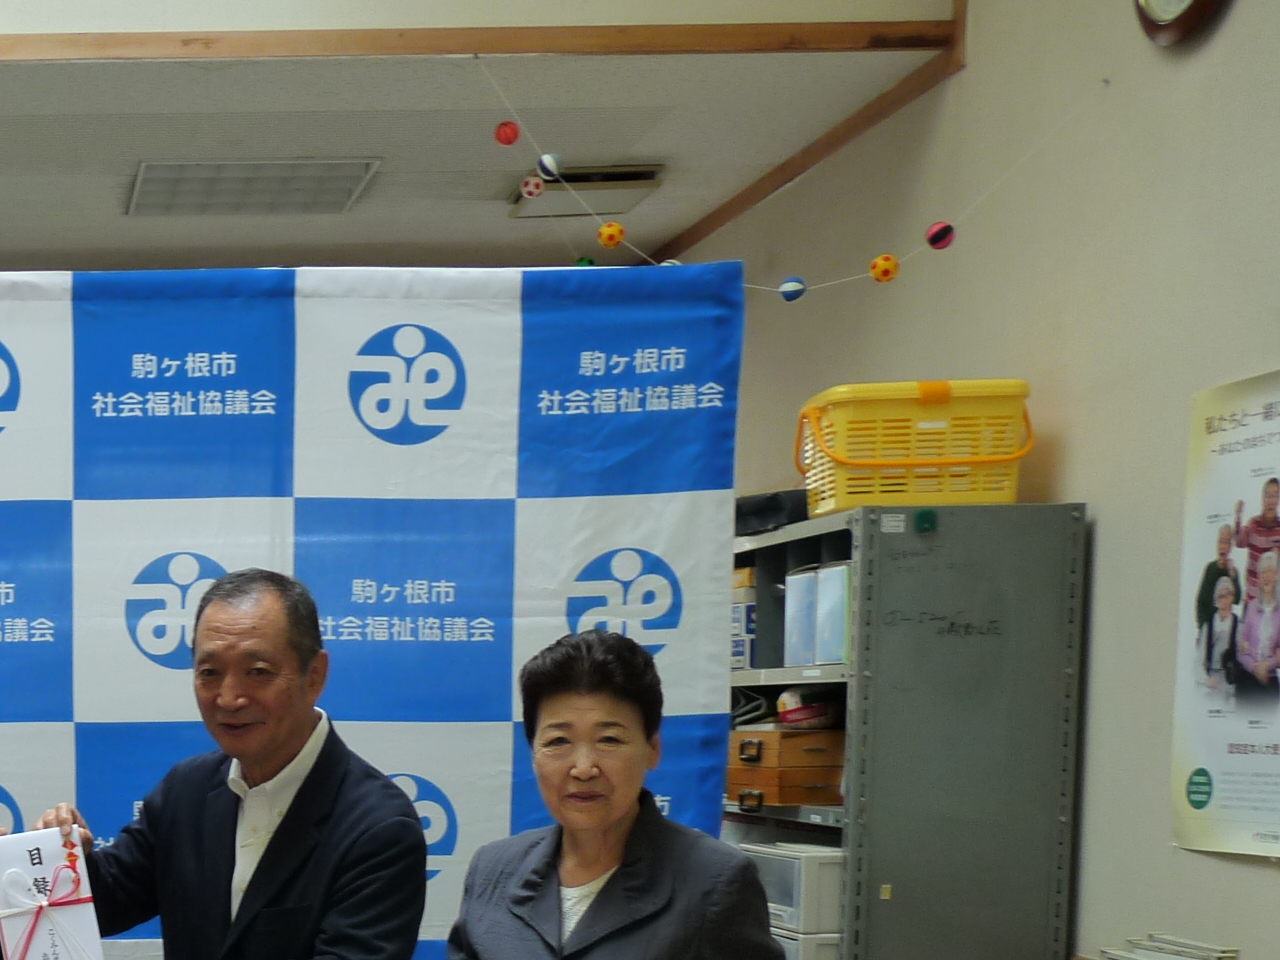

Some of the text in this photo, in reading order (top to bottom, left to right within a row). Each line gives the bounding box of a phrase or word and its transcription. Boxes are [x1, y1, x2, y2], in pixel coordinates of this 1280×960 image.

[131, 351, 237, 378] 駒ヶ根市
[579, 346, 687, 376] 駒ヶ根市
[91, 389, 277, 417] 社会福祉協議会
[537, 383, 724, 415] 社会福祉協議会
[351, 578, 457, 605] 駒ヶ根市
